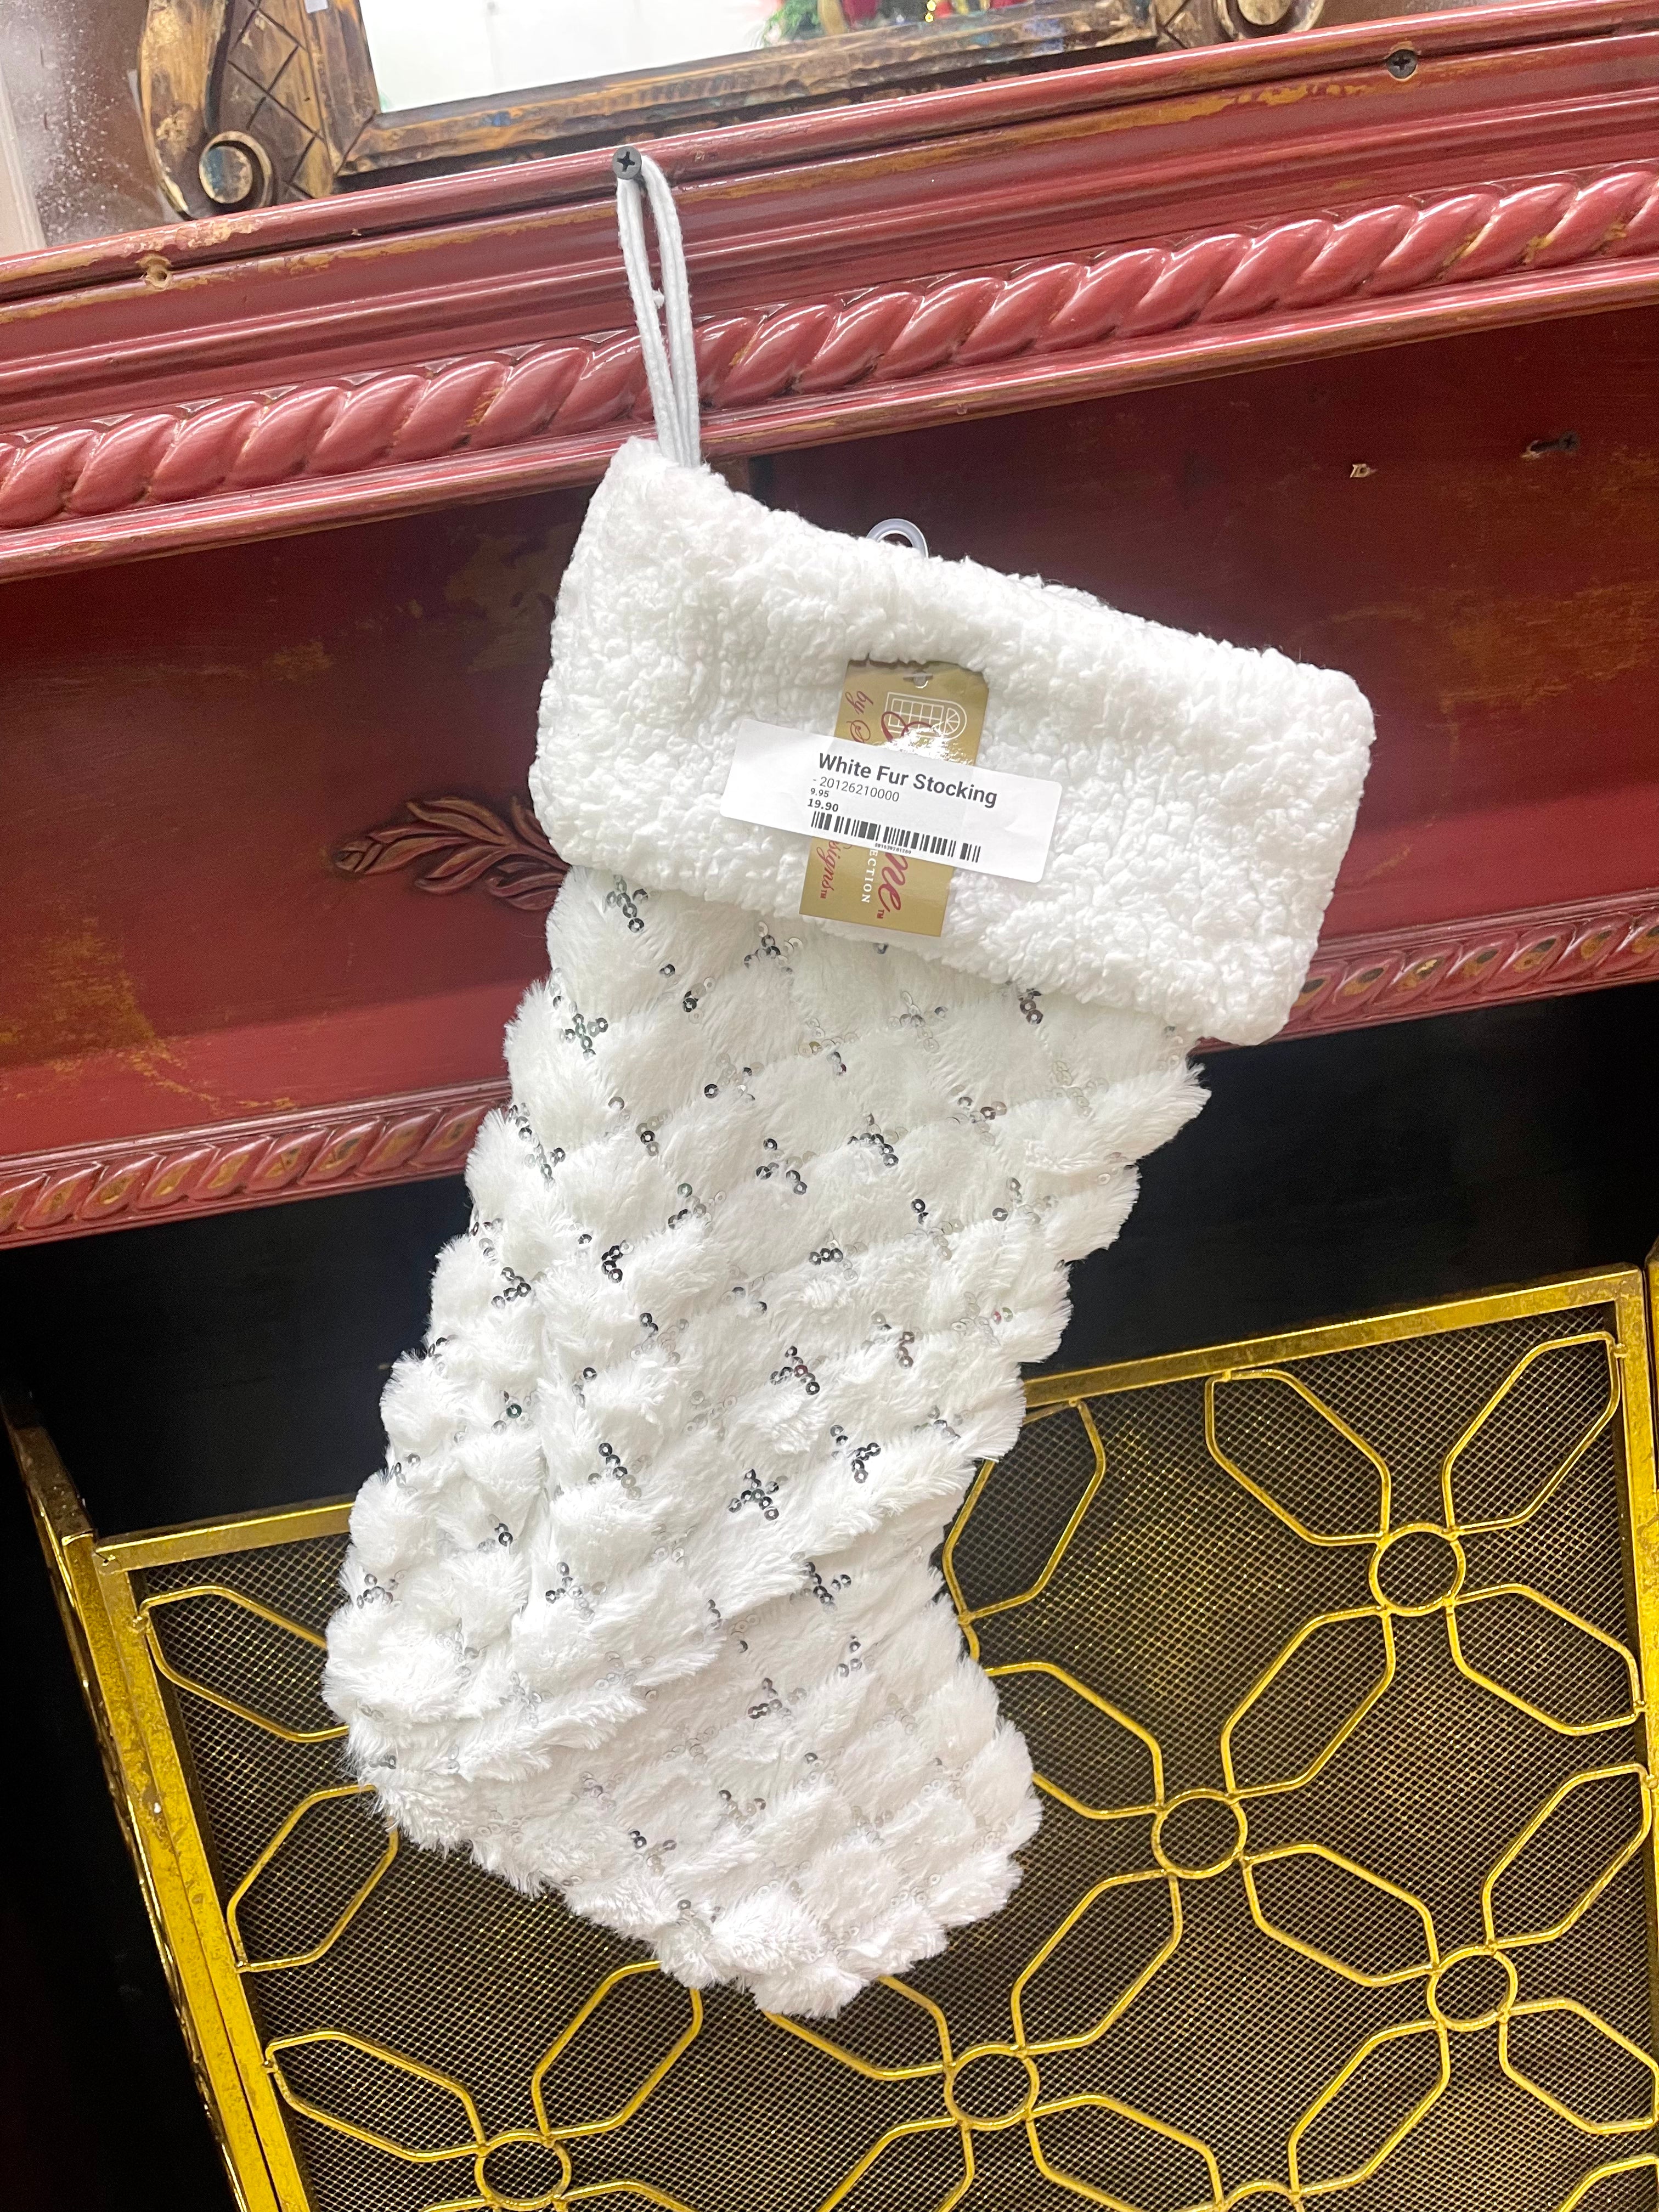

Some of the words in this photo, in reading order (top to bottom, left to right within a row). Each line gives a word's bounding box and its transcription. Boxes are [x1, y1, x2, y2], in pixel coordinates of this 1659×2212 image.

[844, 691, 874, 715] by
[810, 787, 830, 798] 9.95
[819, 752, 871, 778] White
[876, 765, 909, 786] Fur
[913, 773, 997, 809] Stocking
[820, 776, 900, 802] 20126210000
[807, 798, 839, 812] 19.90
[861, 849, 878, 904] ECTION
